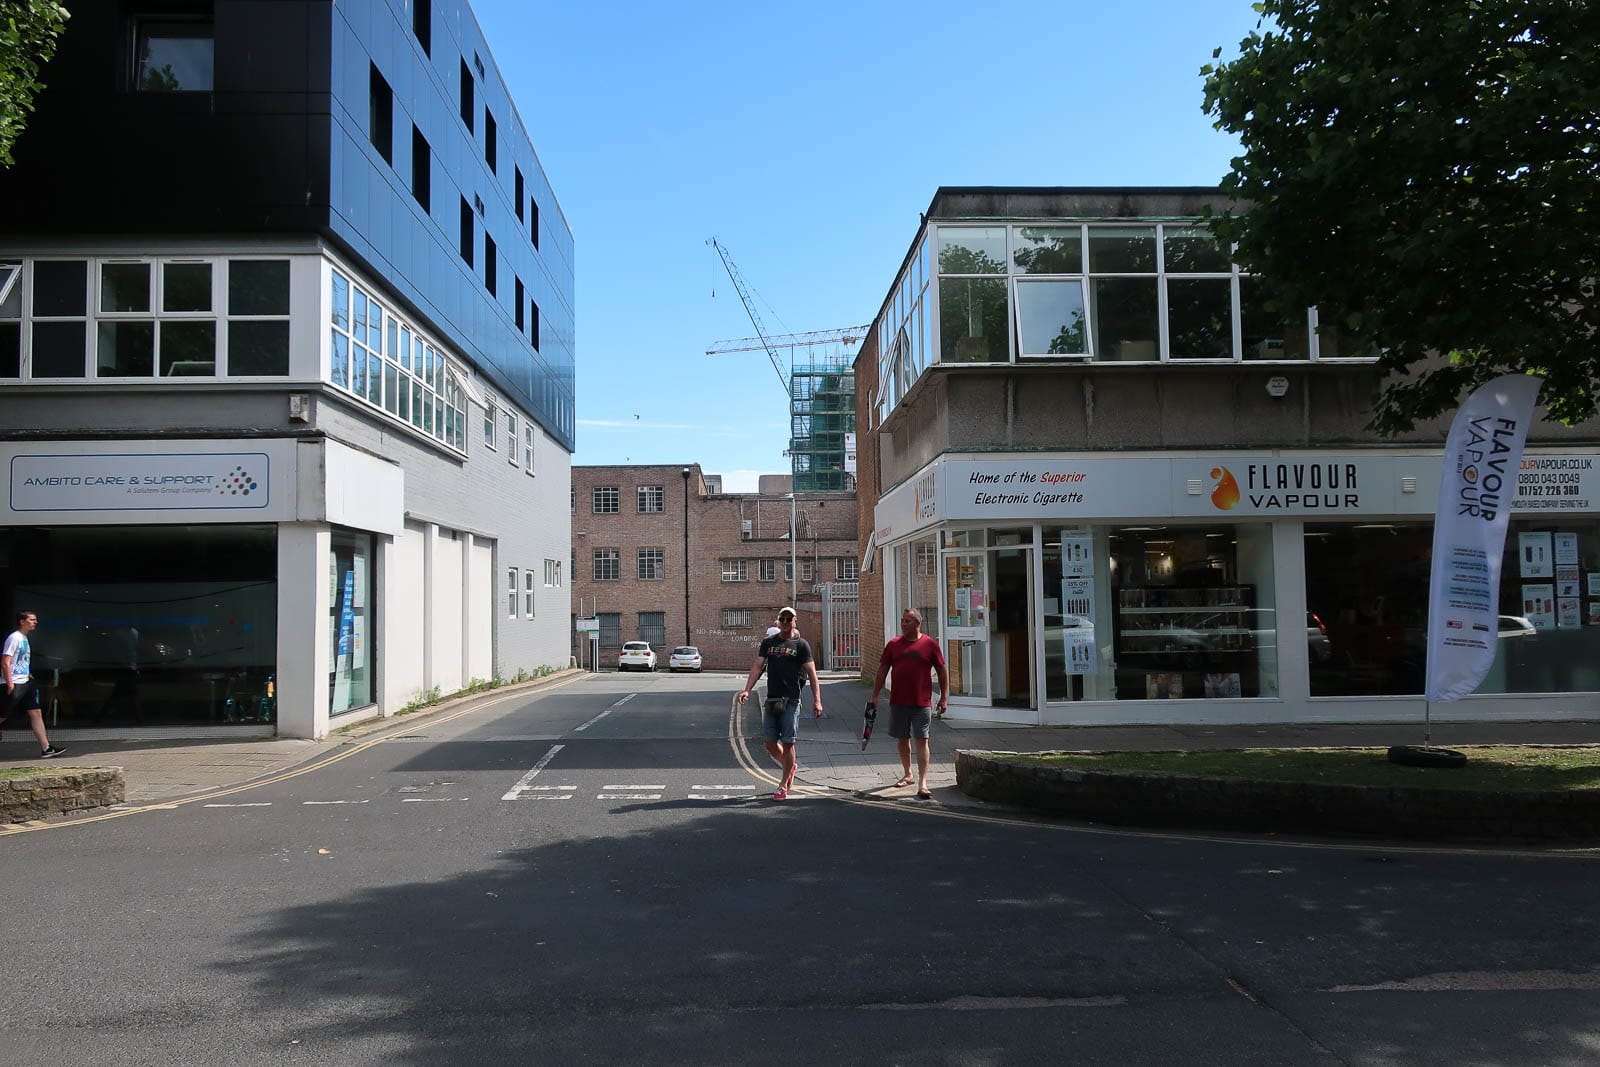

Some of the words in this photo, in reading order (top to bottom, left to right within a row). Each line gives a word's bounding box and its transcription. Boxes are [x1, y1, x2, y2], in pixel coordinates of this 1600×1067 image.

[1459, 416, 1492, 518] VAPOUR
[1480, 417, 1516, 522] FLAVOUR
[1520, 460, 1592, 470] OURVAPOUR.CO.UK
[23, 476, 81, 487] AMBITO
[84, 475, 126, 486] CARE
[128, 475, 141, 486] &
[143, 474, 215, 486] SUPPORT
[969, 471, 1000, 484] Home
[1003, 471, 1018, 484] of
[1020, 471, 1037, 483] the
[1040, 471, 1088, 486] Superior
[1248, 463, 1357, 490] FLAVOUR
[1541, 473, 1557, 484] 043
[1559, 473, 1580, 484] 0049
[1518, 485, 1543, 496] 01752
[974, 492, 1029, 505] Electronic
[1032, 491, 1084, 506] Cigarette
[1248, 494, 1359, 508] VAPOUR
